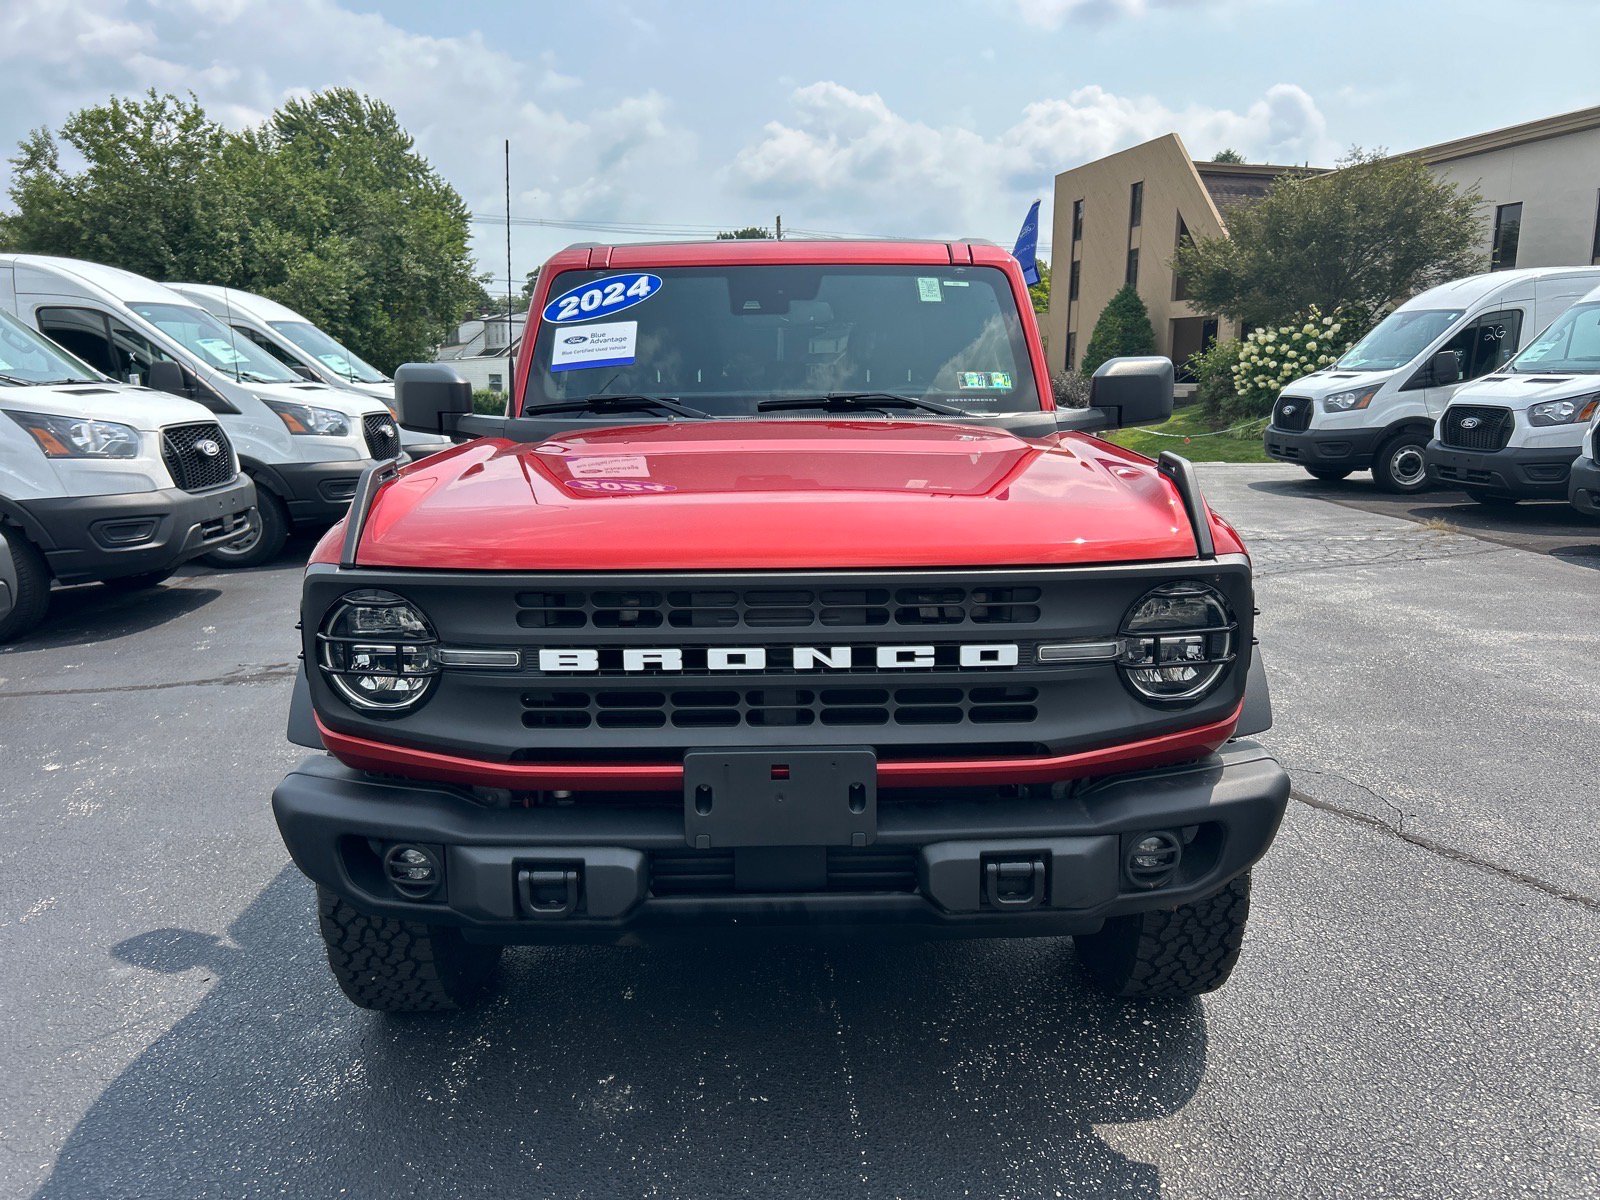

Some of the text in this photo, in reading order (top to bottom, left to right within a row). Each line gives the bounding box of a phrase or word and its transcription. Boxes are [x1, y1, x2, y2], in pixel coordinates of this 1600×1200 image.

[556, 275, 651, 320] 2024
[590, 336, 628, 345] Advantage
[539, 644, 1019, 672] BRONCO
